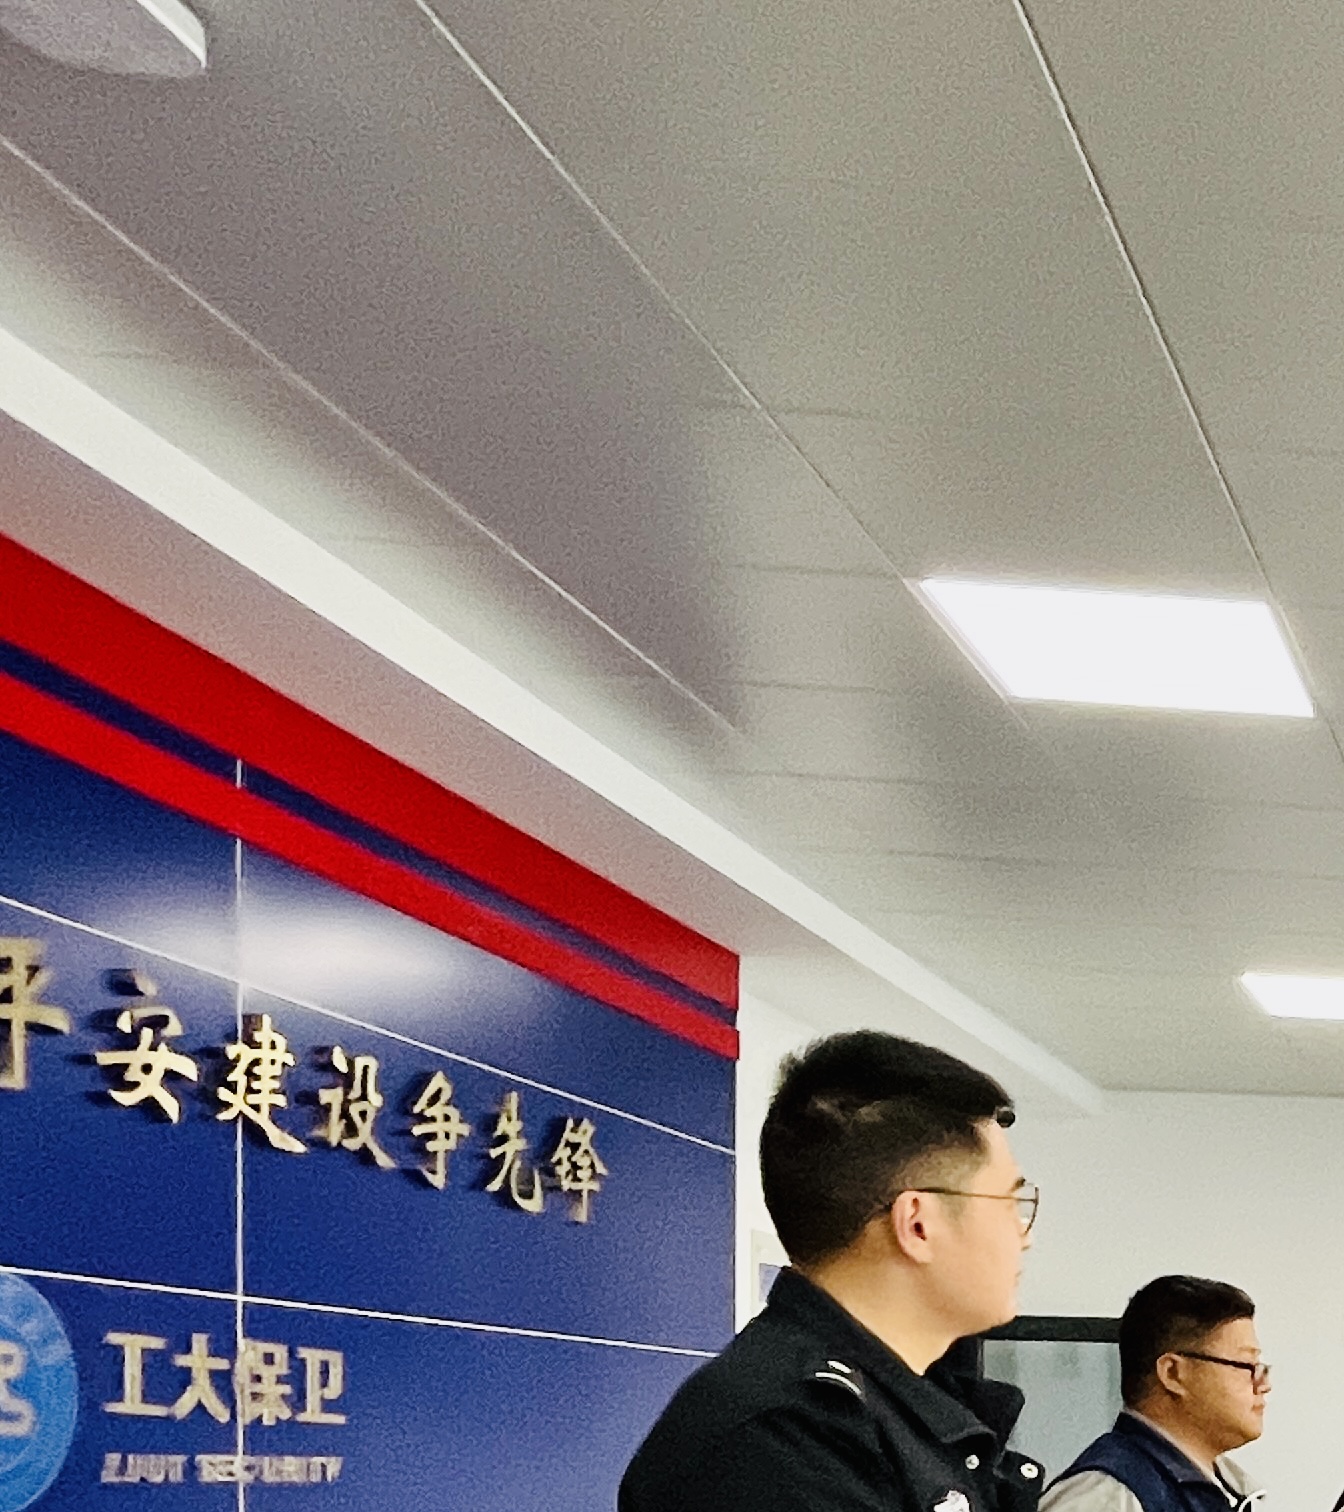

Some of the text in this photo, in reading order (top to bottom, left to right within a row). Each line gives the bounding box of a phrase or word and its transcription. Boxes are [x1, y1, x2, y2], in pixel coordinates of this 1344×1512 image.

[101, 1331, 347, 1426] 工大保卫
[195, 1453, 345, 1484] SECURITY
